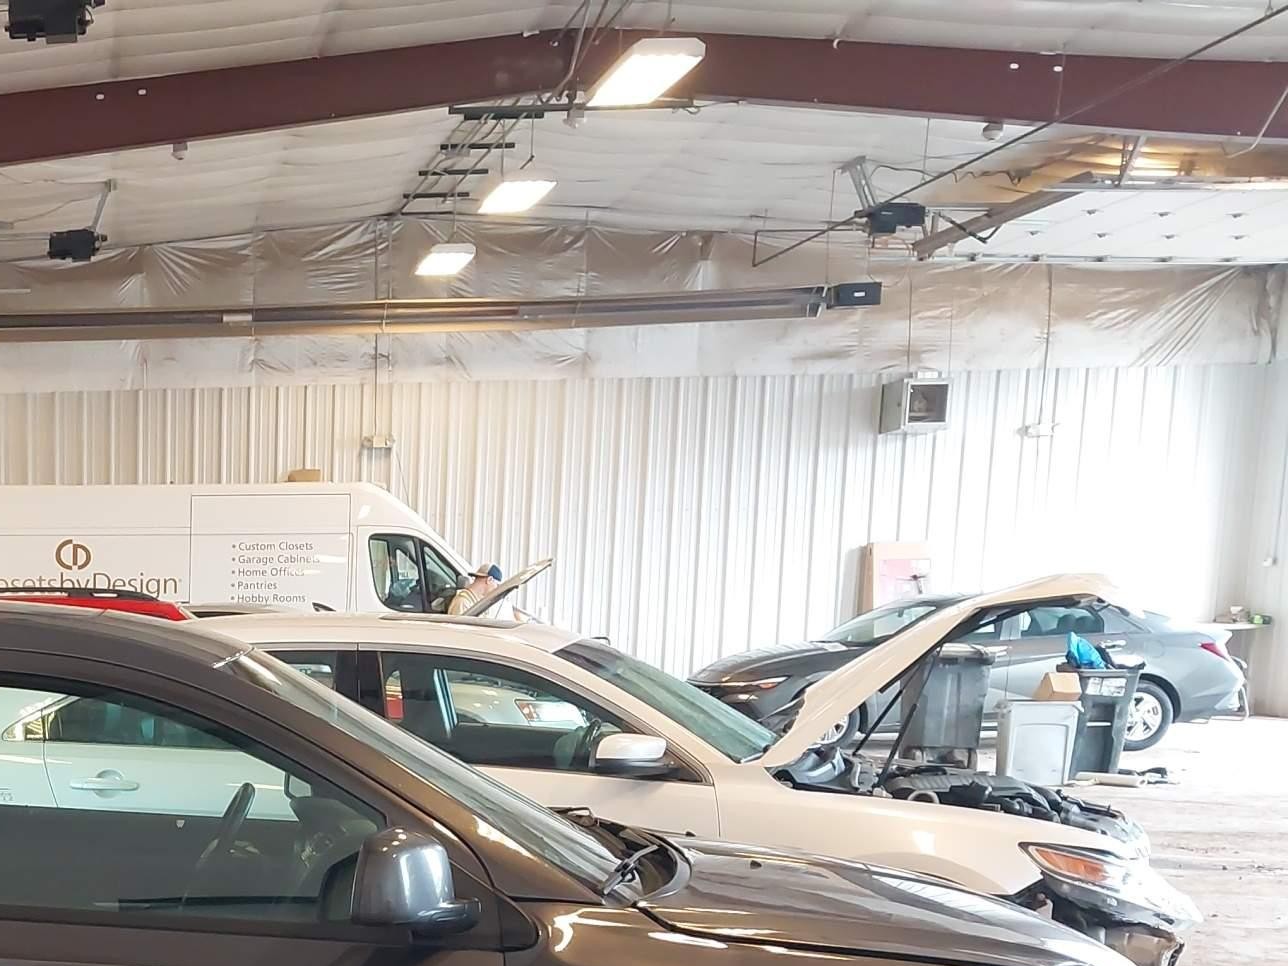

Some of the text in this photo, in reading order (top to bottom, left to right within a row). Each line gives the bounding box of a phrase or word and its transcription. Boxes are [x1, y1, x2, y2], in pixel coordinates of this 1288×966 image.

[238, 541, 314, 551] Custom Closets
[238, 555, 274, 566] Garage
[237, 567, 267, 577] Home
[237, 581, 278, 590] Pantries
[237, 593, 306, 604] Hobby Rooms
